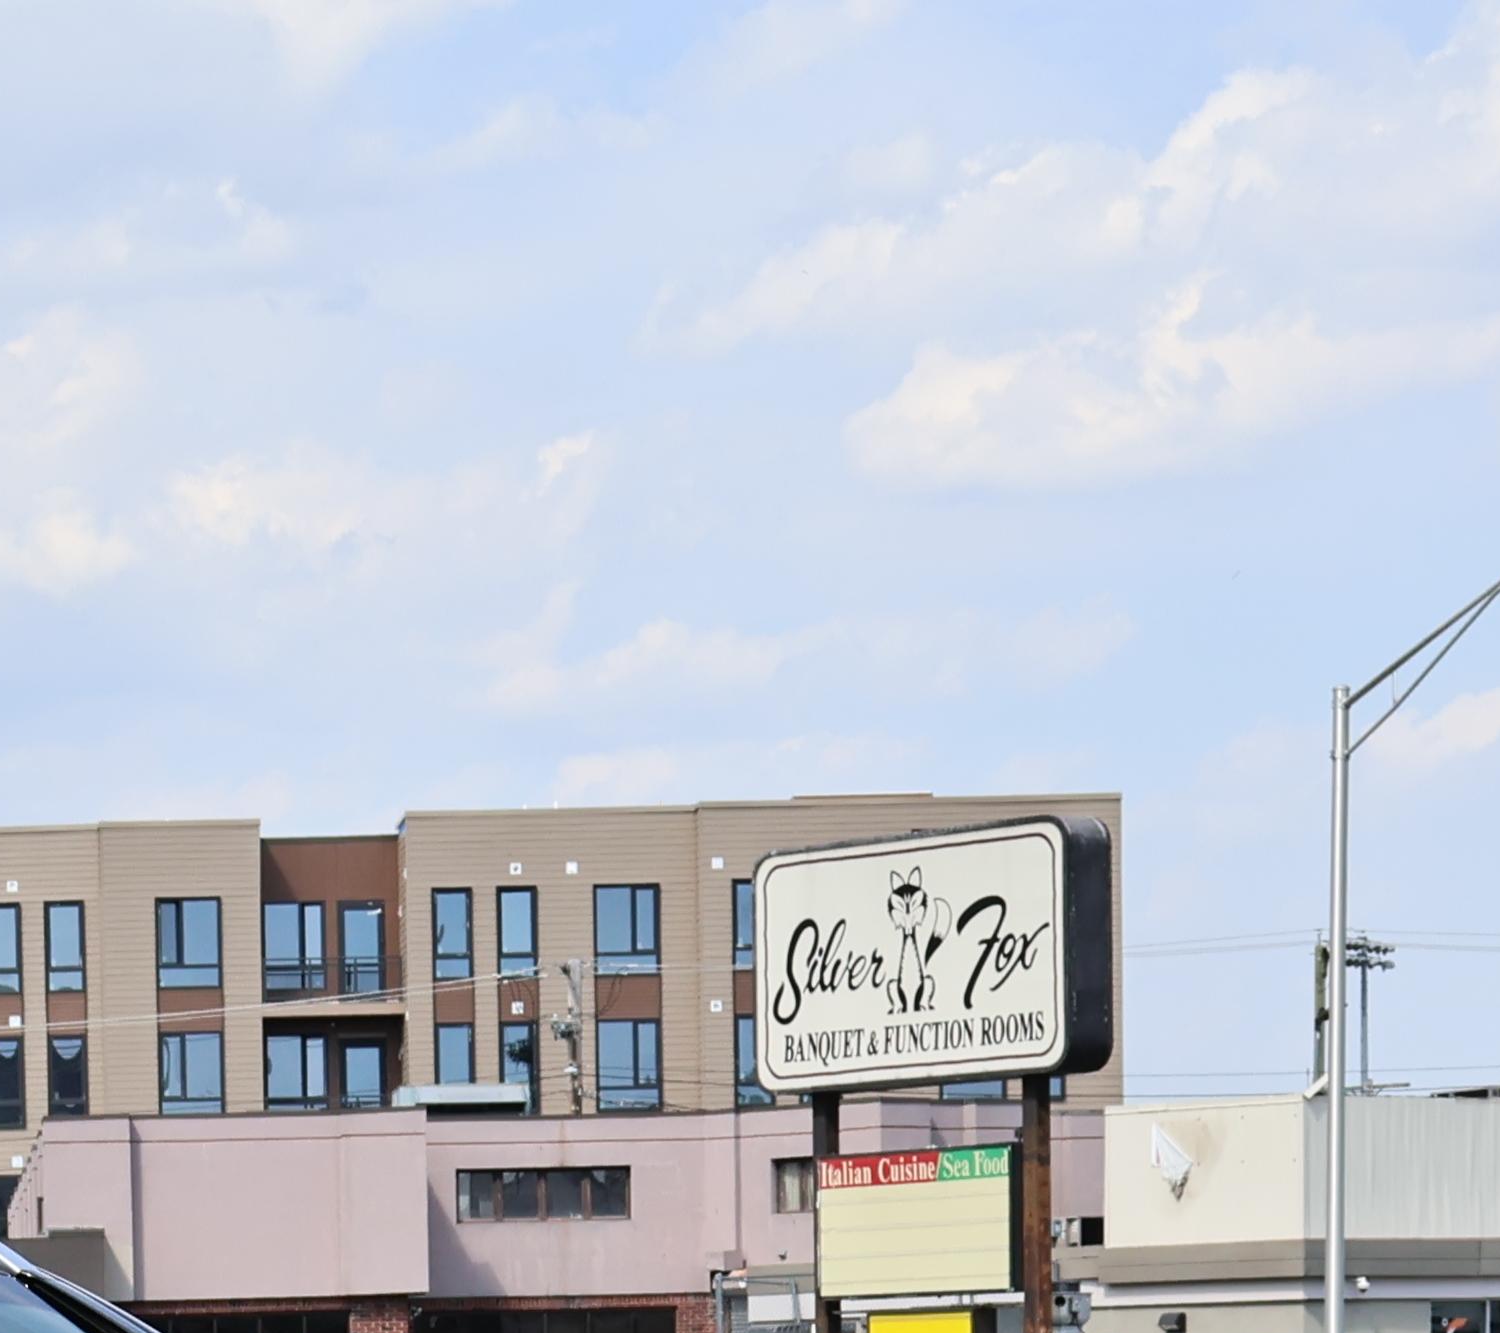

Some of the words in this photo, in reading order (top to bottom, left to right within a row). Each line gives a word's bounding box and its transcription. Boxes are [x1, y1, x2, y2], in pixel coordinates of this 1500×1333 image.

[773, 918, 886, 1025] Silver
[956, 895, 1050, 1010] Fox
[783, 1028, 865, 1067] BANQUET
[868, 1033, 880, 1056] &
[883, 1018, 975, 1055] FUNCTION
[981, 1011, 1045, 1045] ROOMS
[821, 1160, 872, 1188] Italian
[974, 1150, 1009, 1176] Food
